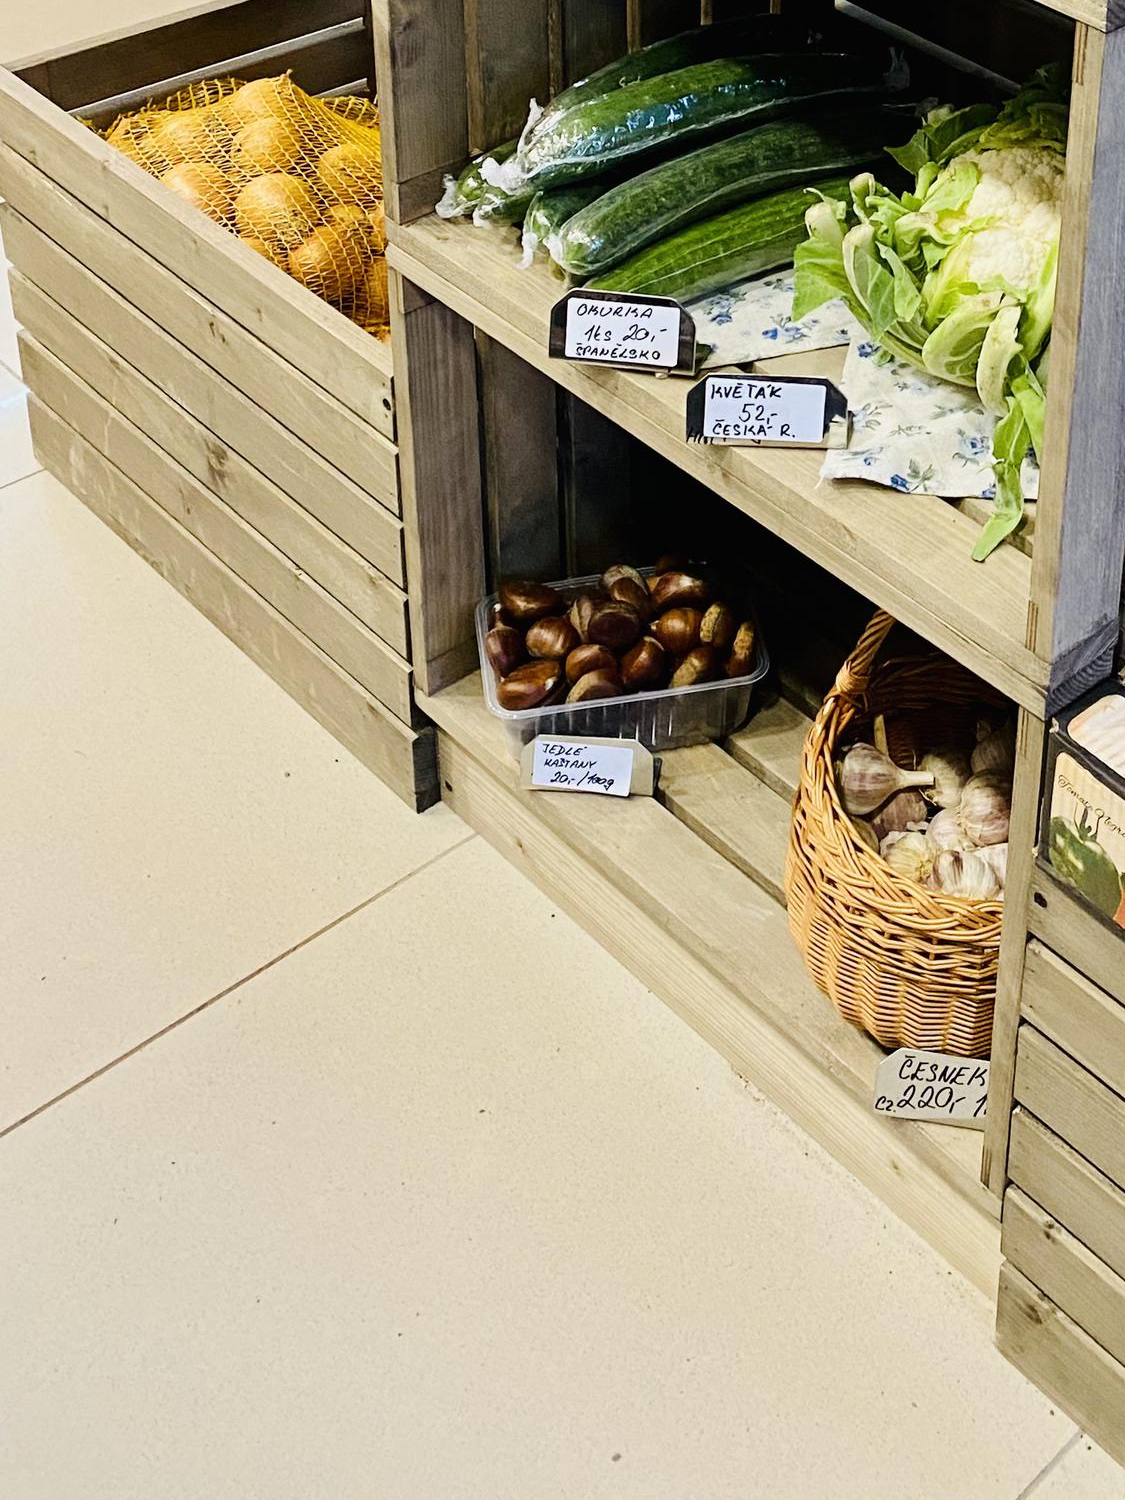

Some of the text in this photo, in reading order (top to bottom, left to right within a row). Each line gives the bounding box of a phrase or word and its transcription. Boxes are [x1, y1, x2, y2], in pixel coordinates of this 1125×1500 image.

[576, 303, 654, 319] OKURKA
[622, 323, 668, 343] 20,-
[710, 382, 783, 400] KVĚTÁK
[738, 403, 779, 425] 52,-
[780, 423, 797, 438] R.
[541, 743, 588, 756] JEDLÉ
[543, 758, 598, 770] KAŠTANY
[1057, 774, 1094, 812] Tomate
[898, 1054, 988, 1087] ČESNEK
[897, 1084, 967, 1114] 220,-
[973, 1093, 988, 1118] 1
